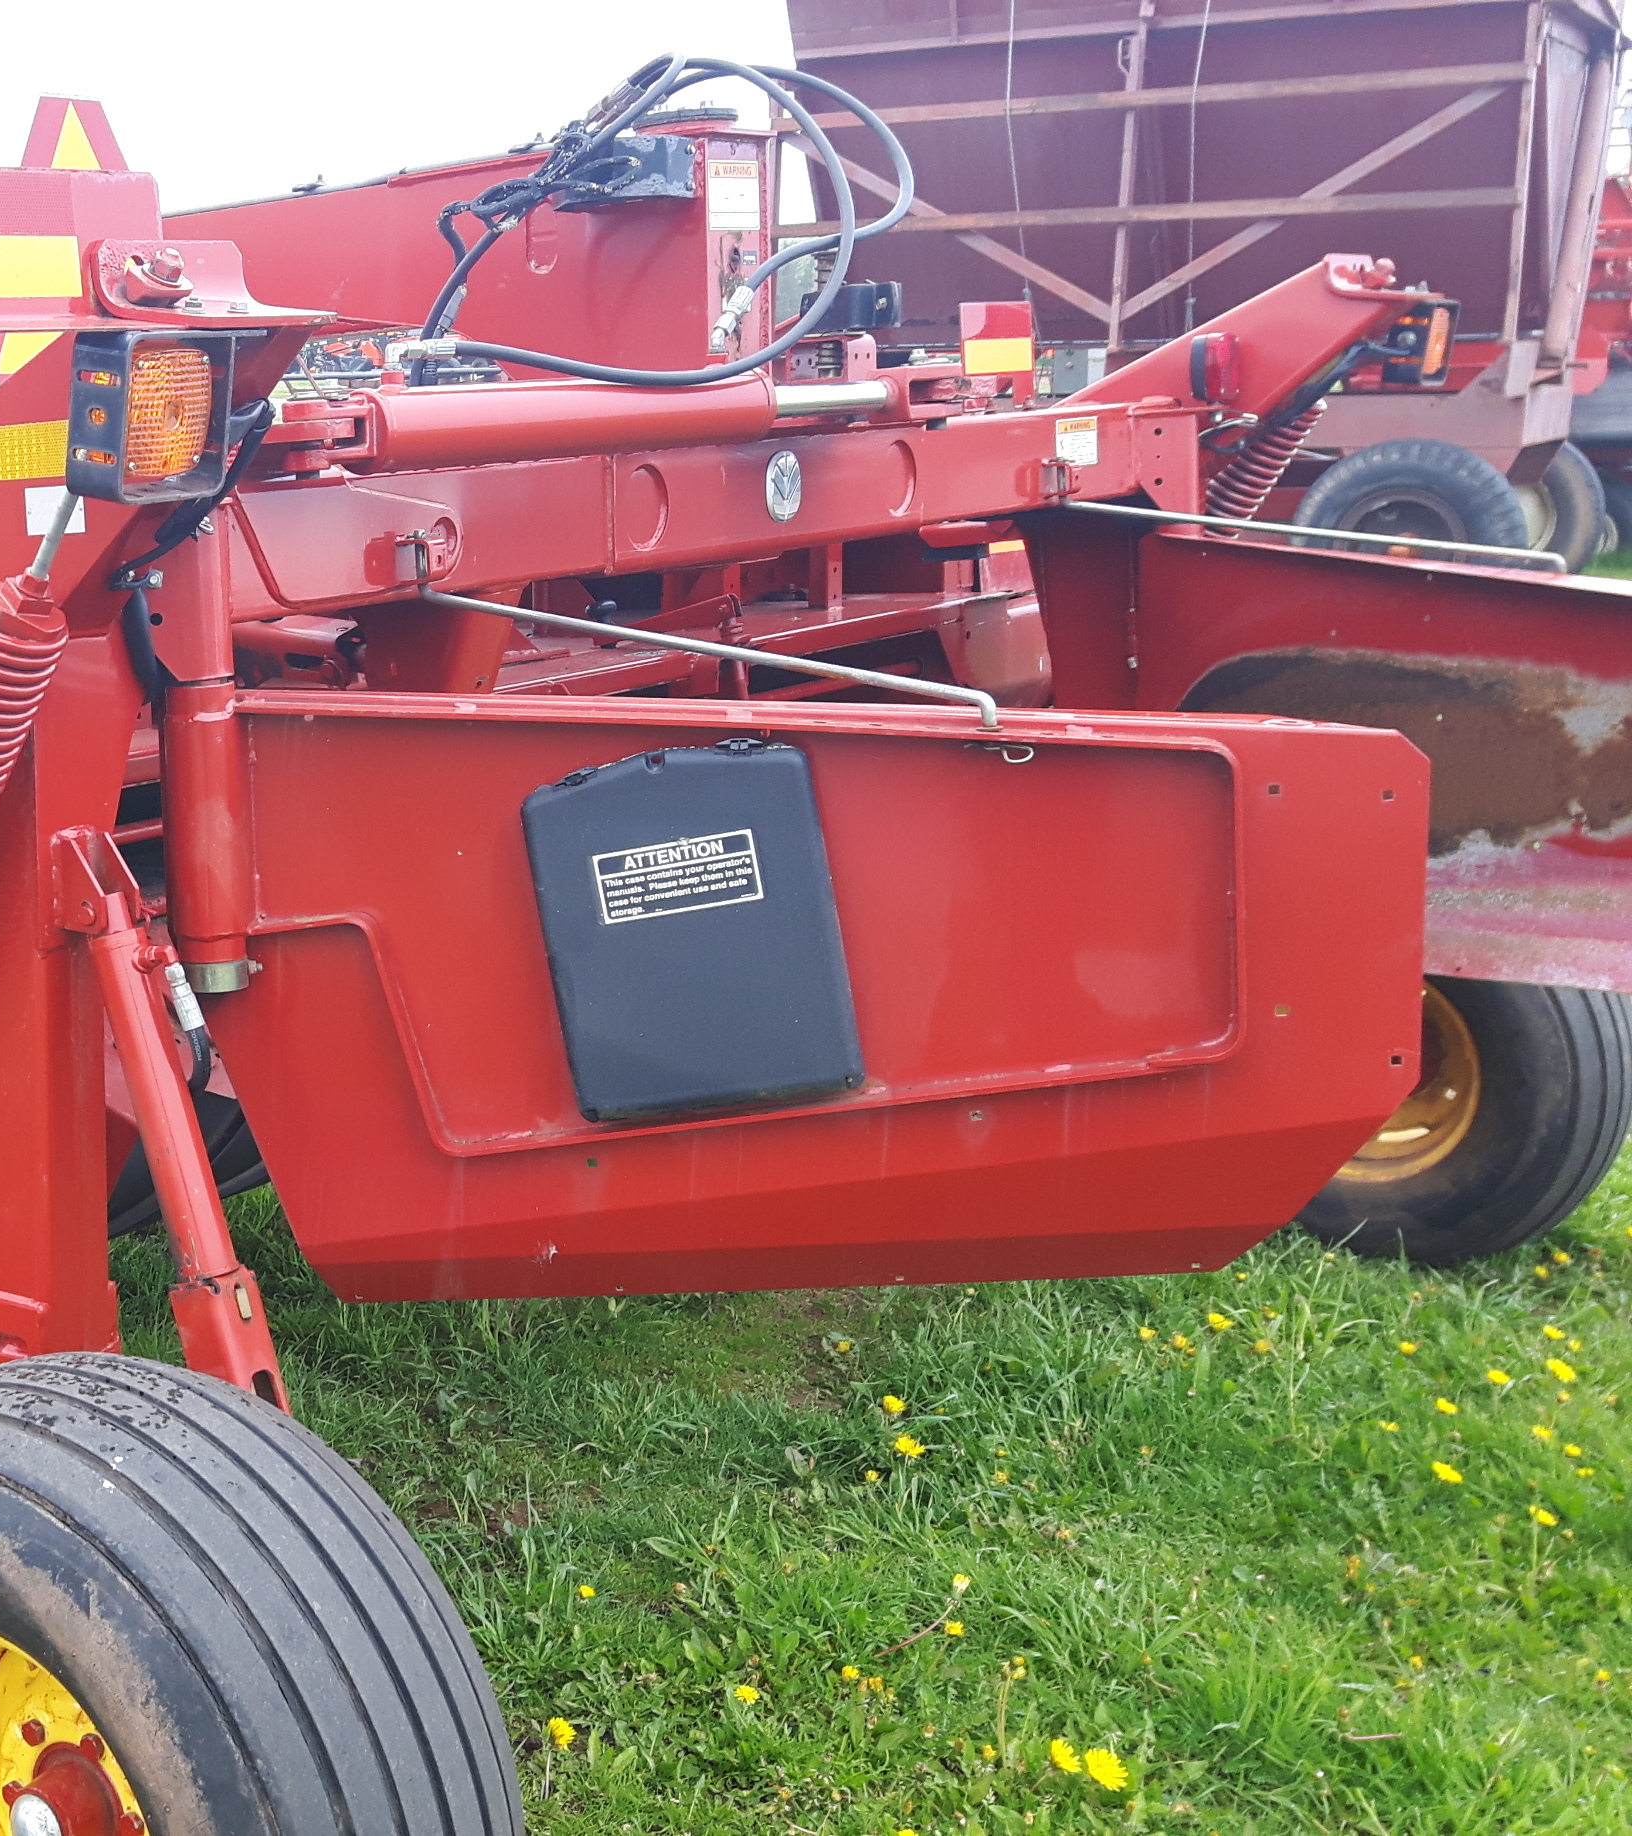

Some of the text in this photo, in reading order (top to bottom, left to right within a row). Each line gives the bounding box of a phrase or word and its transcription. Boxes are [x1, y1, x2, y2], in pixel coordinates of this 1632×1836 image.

[722, 165, 752, 176] WARNING
[624, 839, 724, 870] ATTENTION
[604, 856, 751, 888] This case contains your operator's
[606, 866, 753, 898] manuals. Please keep them in this
[608, 878, 748, 908] case for convenient use and safe
[610, 906, 646, 918] storage.
